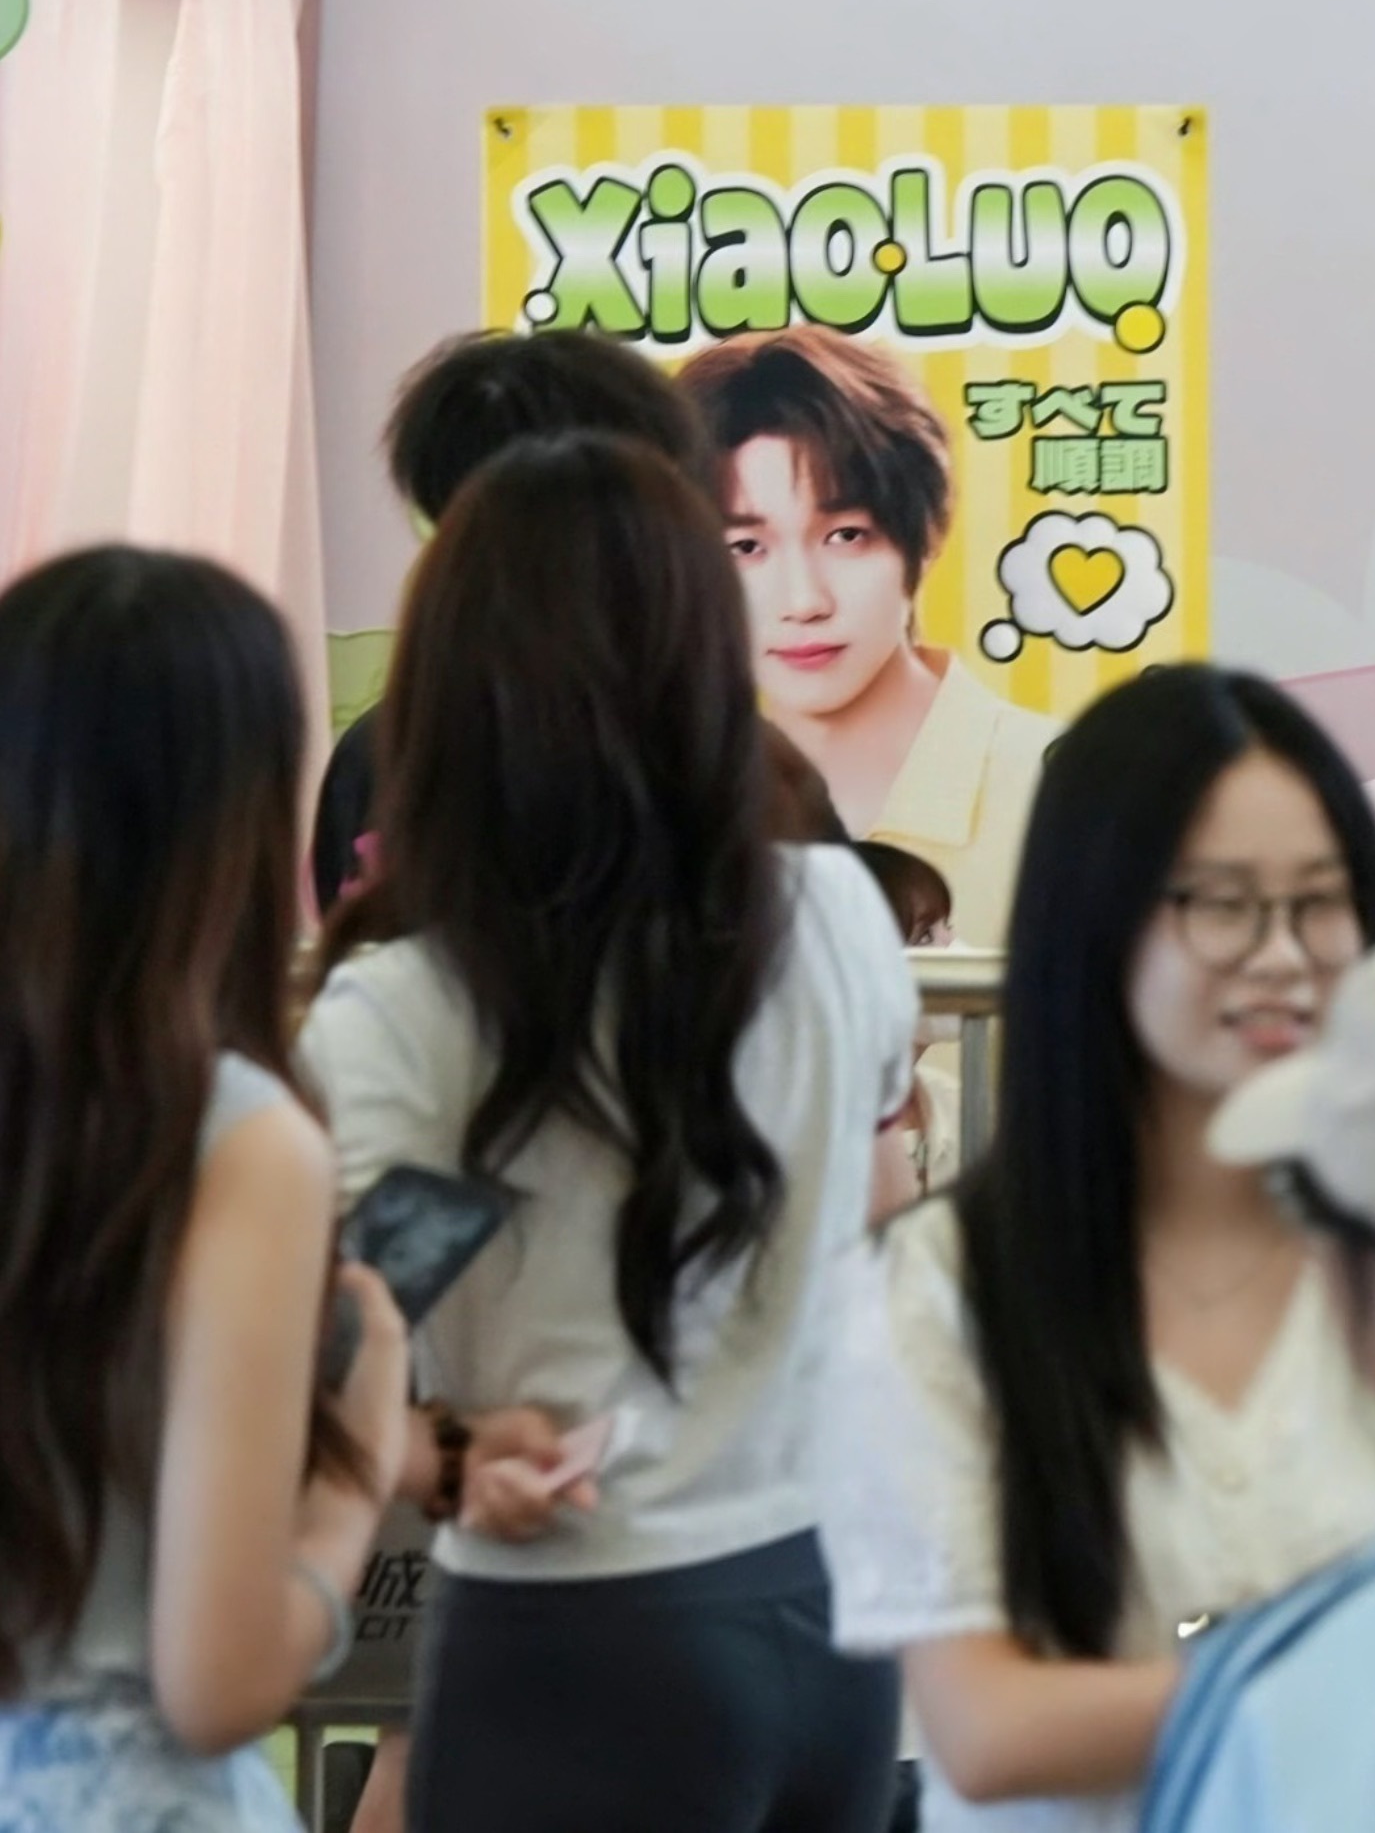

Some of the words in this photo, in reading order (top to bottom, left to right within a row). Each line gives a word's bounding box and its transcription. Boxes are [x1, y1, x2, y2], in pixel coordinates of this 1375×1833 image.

[964, 379, 1167, 441] すべて
[1027, 434, 1168, 495] 順調
